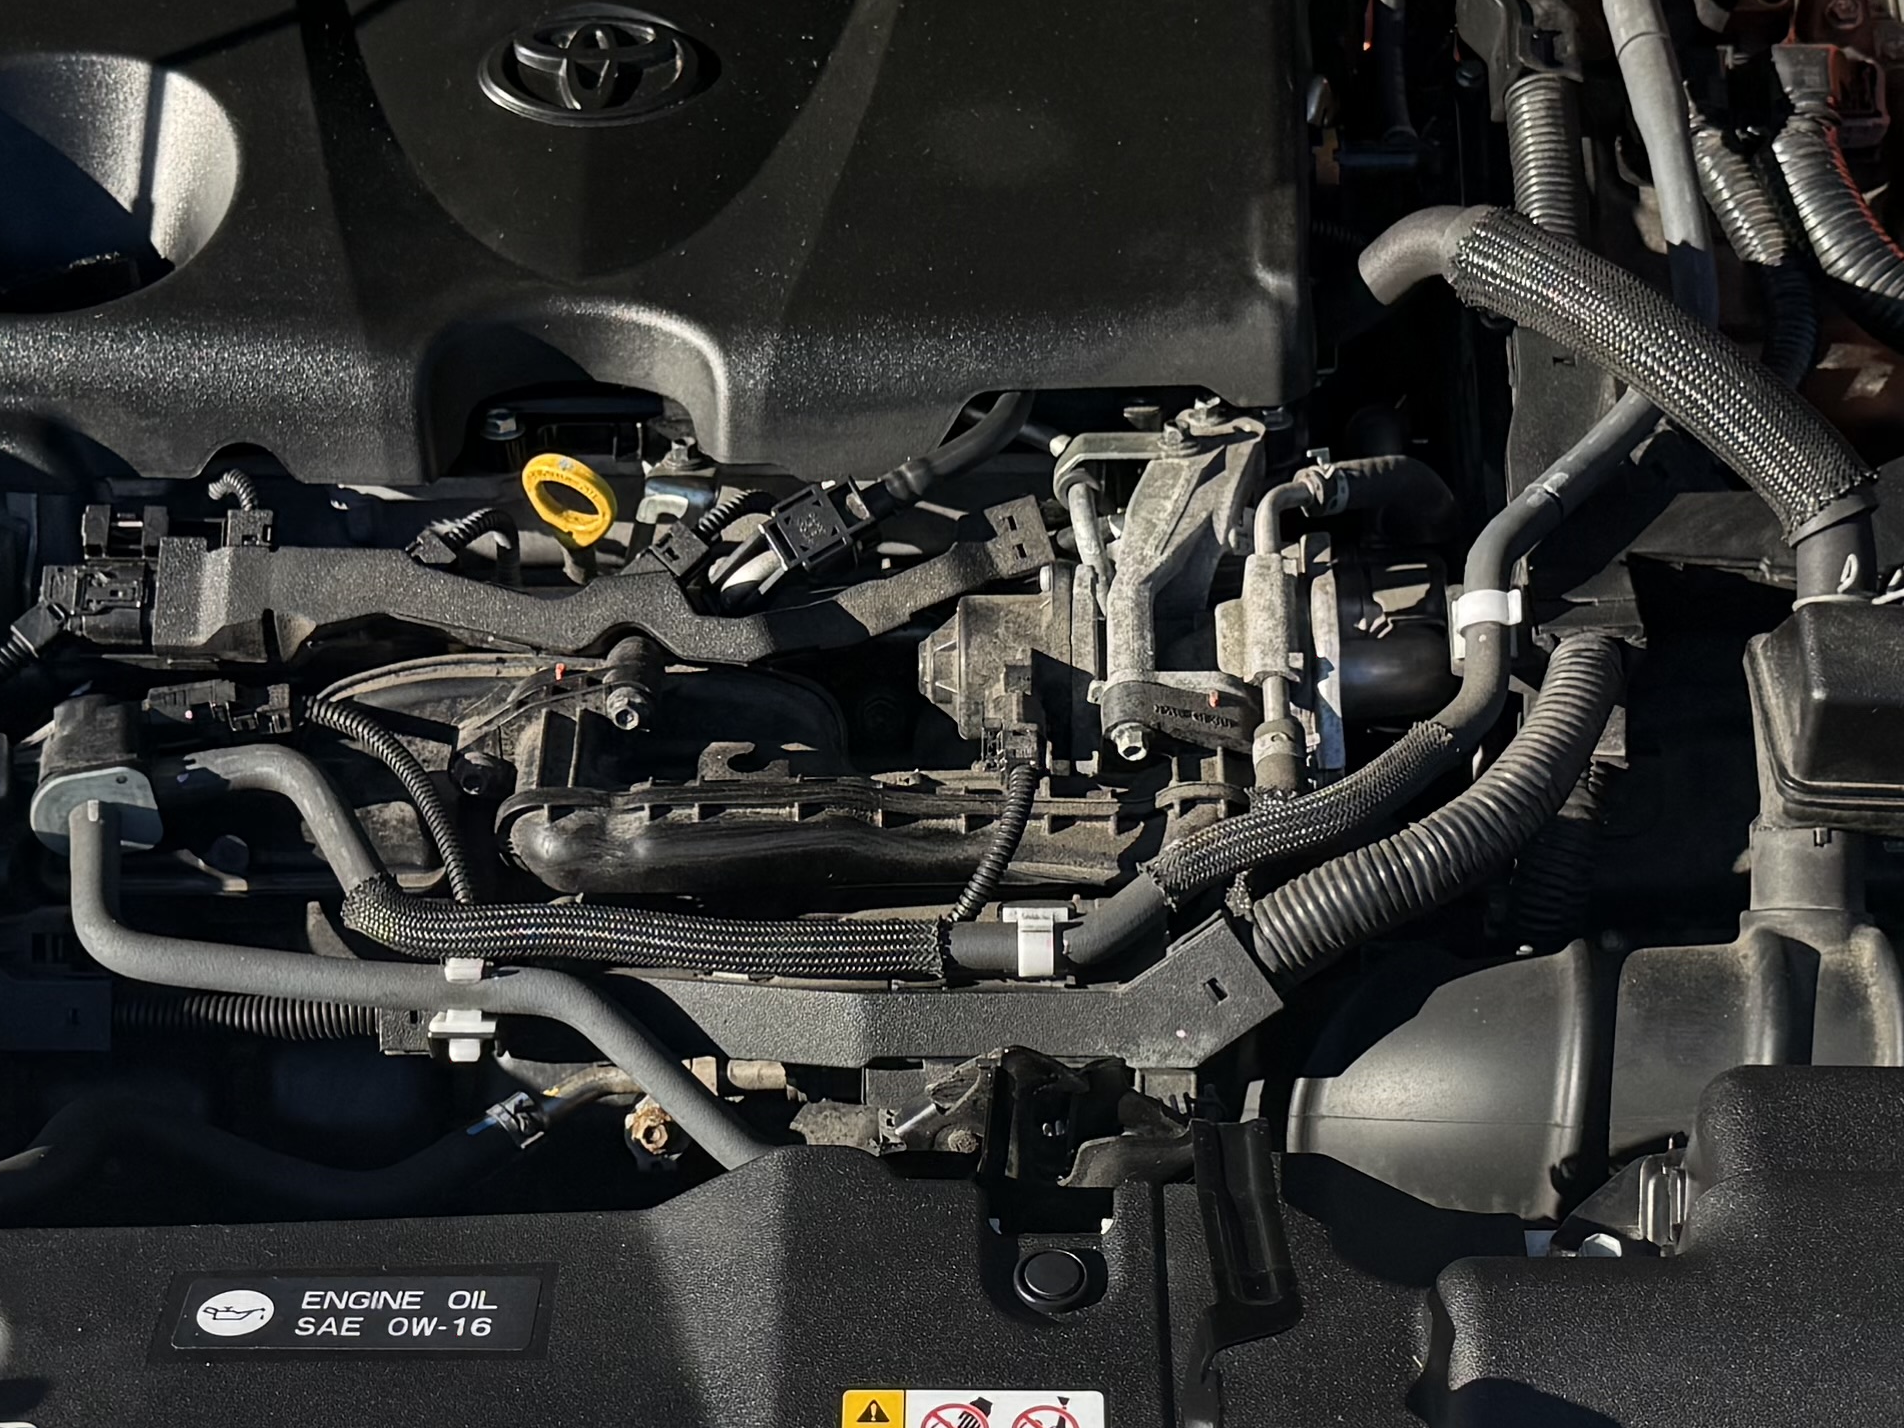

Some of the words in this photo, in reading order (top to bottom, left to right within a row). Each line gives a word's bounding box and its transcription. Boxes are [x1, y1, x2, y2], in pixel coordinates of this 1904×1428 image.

[301, 1291, 425, 1310] ENGINE
[448, 1291, 498, 1310] OIL
[295, 1316, 363, 1337] SAE
[387, 1316, 492, 1337] 0W-16
